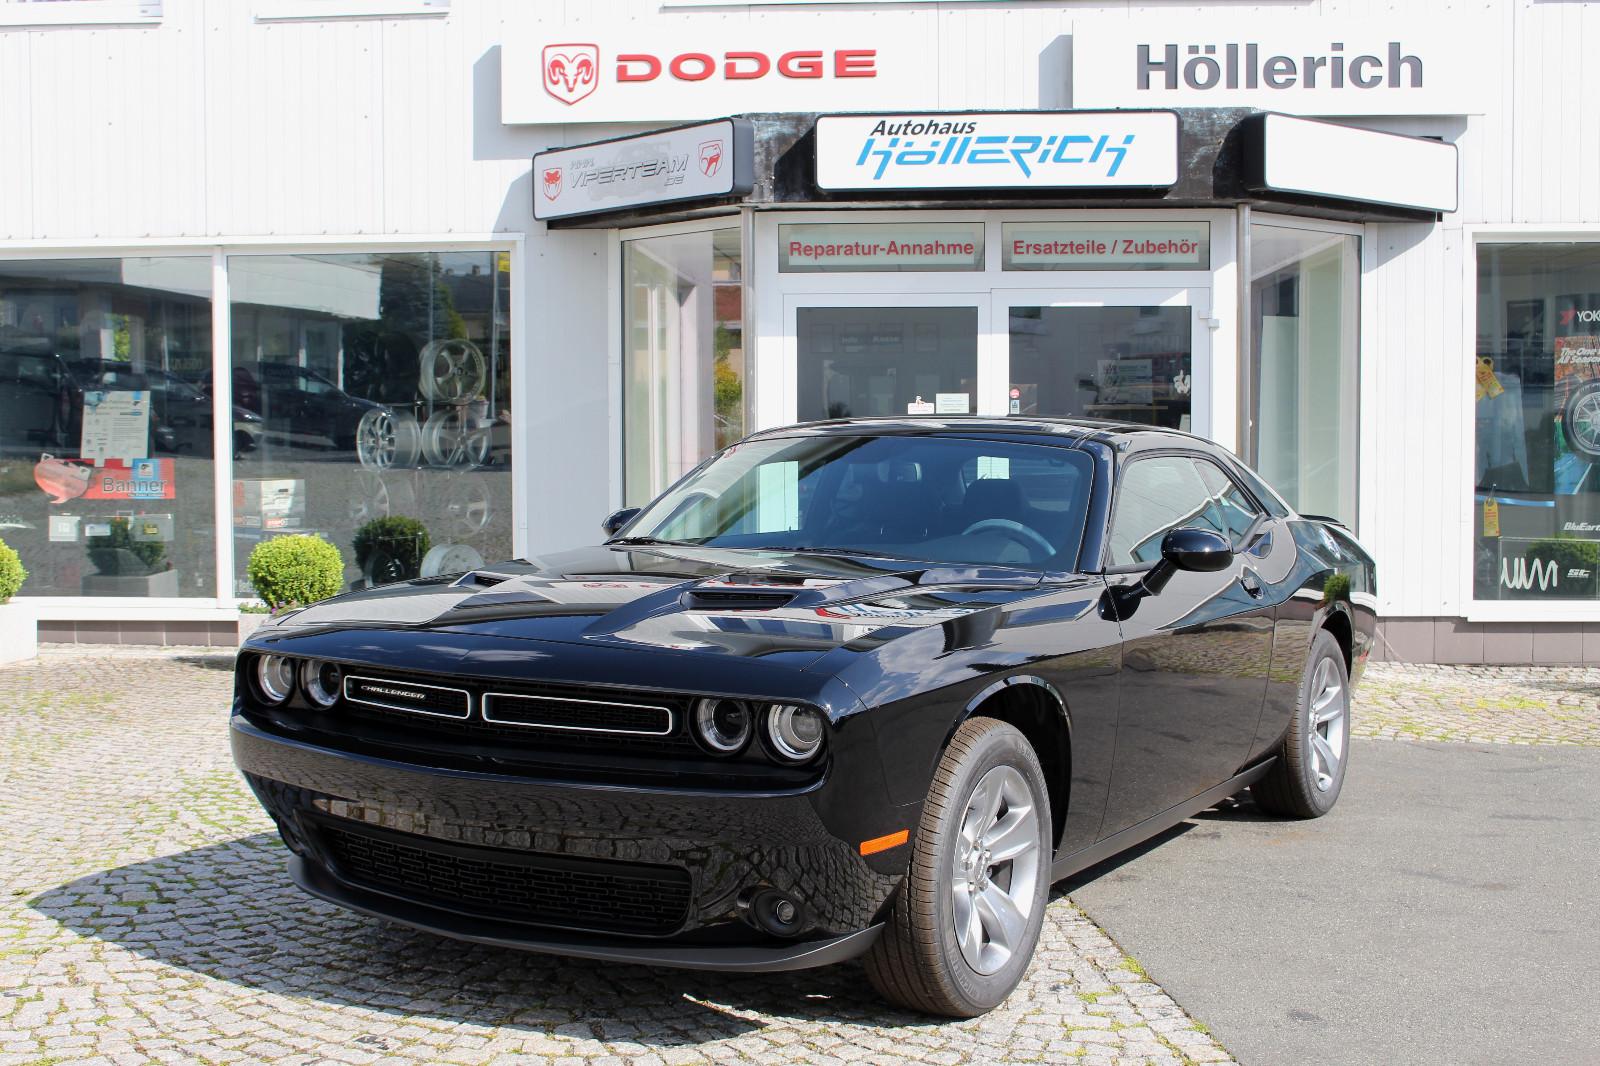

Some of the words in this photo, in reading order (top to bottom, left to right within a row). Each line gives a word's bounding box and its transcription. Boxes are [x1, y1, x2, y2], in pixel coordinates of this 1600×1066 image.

[616, 49, 878, 82] DODGE
[1137, 42, 1423, 90] Höllerich
[870, 119, 978, 136] Autohaus
[571, 154, 689, 189] VIPERTEAM
[790, 239, 975, 261] Reparatur-Annahme
[1013, 239, 1107, 256] Ersatzteile
[1110, 239, 1117, 256] /
[1121, 238, 1199, 255] Zubehör
[103, 477, 167, 492] Banner
[360, 685, 426, 699] CHALLENGER
